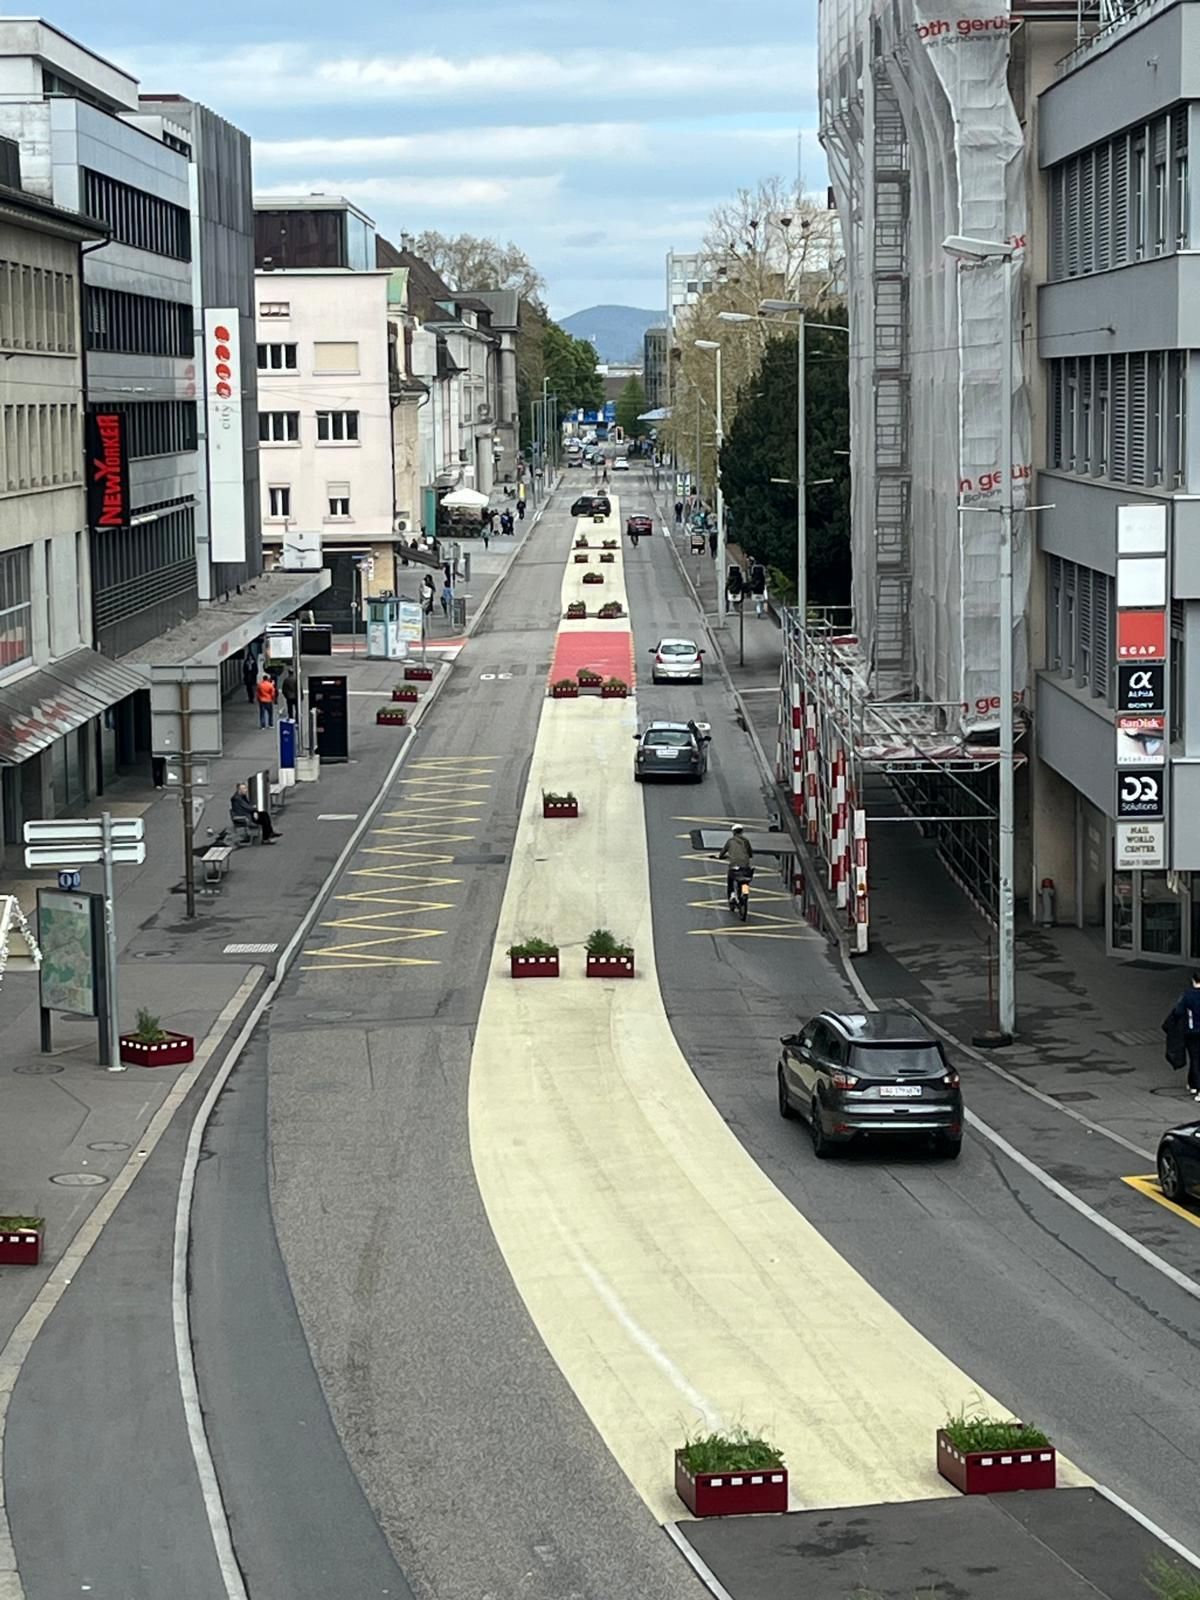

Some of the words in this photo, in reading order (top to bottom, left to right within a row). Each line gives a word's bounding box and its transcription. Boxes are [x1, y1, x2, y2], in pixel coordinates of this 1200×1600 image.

[916, 20, 950, 39] oth
[219, 404, 236, 430] city
[1120, 718, 1160, 728] SanDisk
[1121, 802, 1158, 811] Solutions
[1126, 835, 1155, 843] WORLD
[1124, 845, 1156, 853] CENTER
